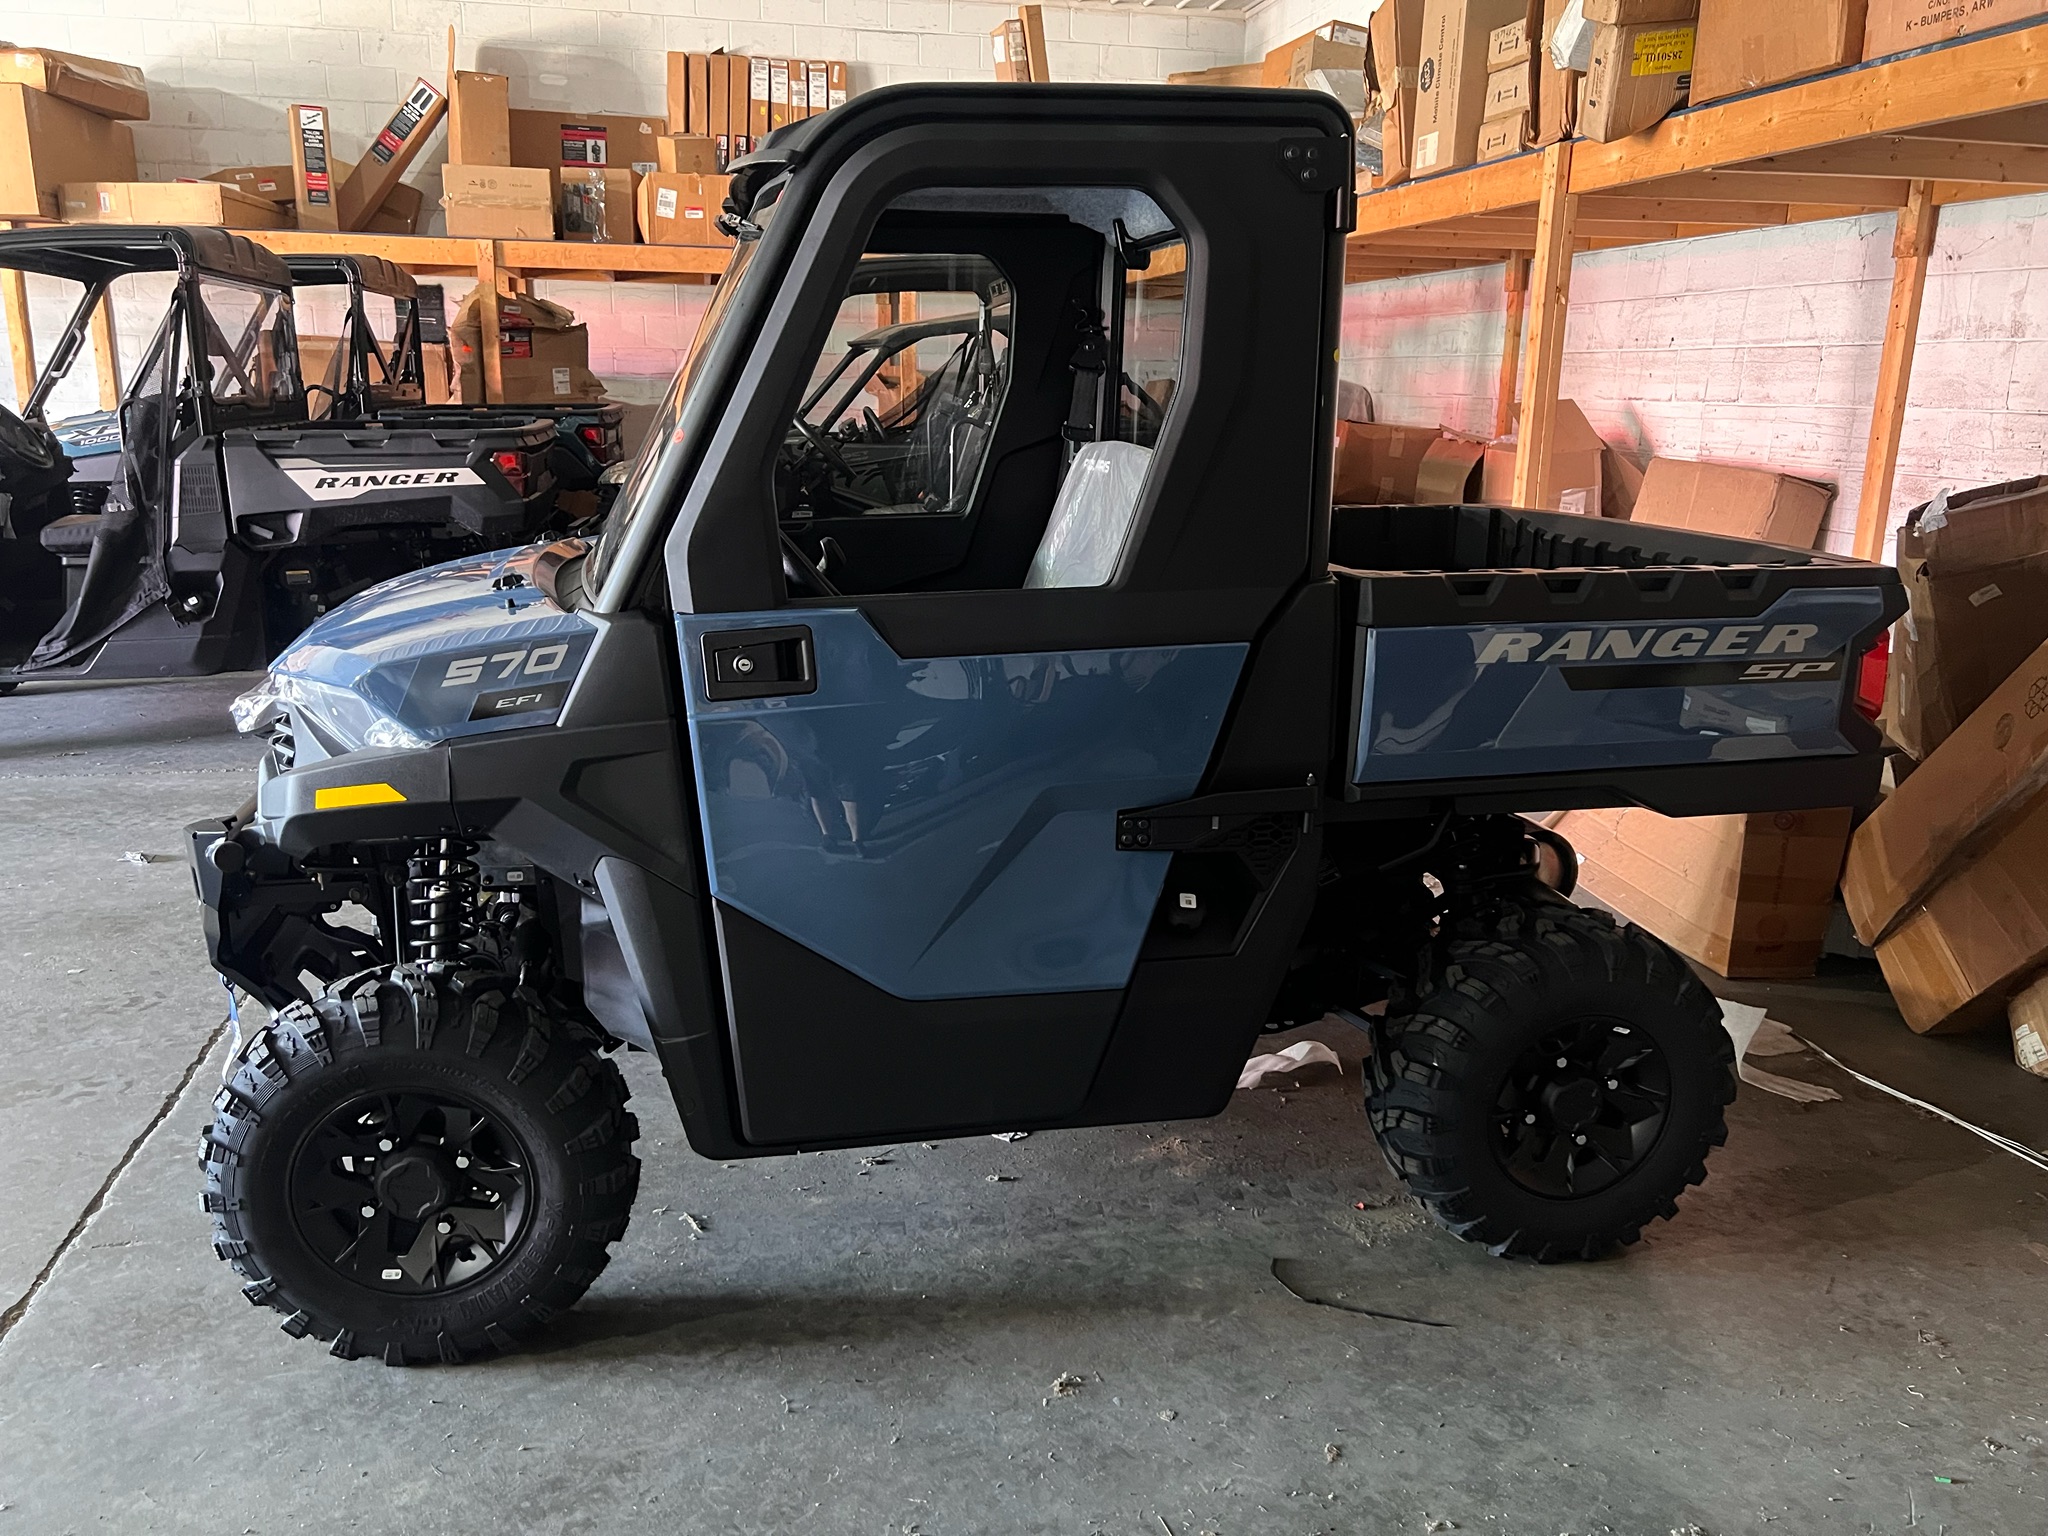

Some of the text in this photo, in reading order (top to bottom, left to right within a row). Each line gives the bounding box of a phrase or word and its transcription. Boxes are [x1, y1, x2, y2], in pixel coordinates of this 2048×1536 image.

[1432, 14, 1447, 124] Mobile Climate Control
[80, 434, 120, 446] 1000
[314, 472, 460, 489] RANGER
[1475, 624, 1819, 664] RANGER
[440, 643, 569, 688] 570
[1738, 662, 1837, 681] SP
[495, 693, 543, 709] EFI
